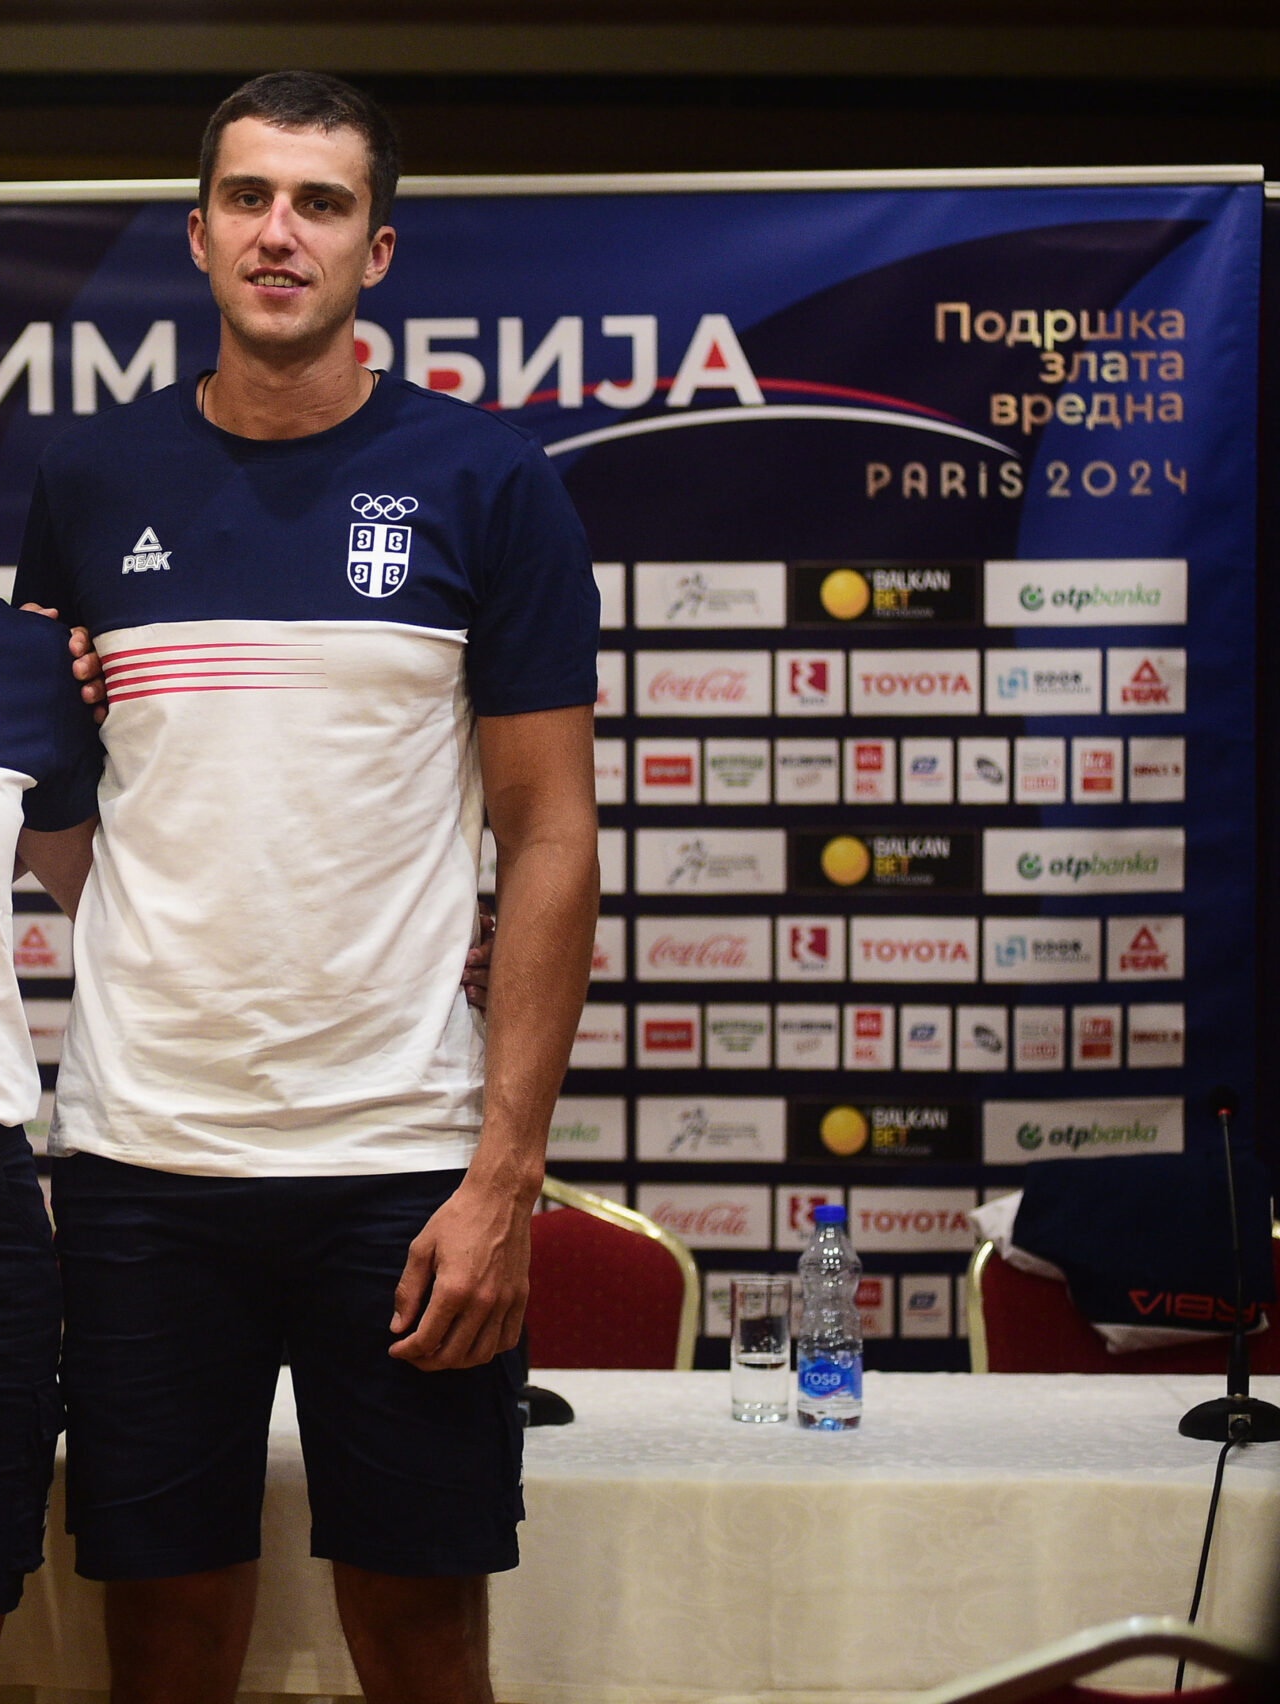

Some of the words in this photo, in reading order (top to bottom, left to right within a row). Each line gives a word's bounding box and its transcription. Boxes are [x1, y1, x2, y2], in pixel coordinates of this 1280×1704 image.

[935, 302, 1186, 351] Подршка
[1039, 350, 1185, 384] злата
[990, 391, 1184, 435] вредна
[866, 461, 1024, 498] PARIS
[1046, 459, 1187, 498] 2024
[121, 551, 173, 575] PEAK
[873, 569, 951, 591] BALKAN
[861, 671, 971, 695] TOYOTA
[861, 938, 970, 964] TOYOTA
[859, 1209, 968, 1233] TOYOTA
[804, 1371, 841, 1386] rosa
